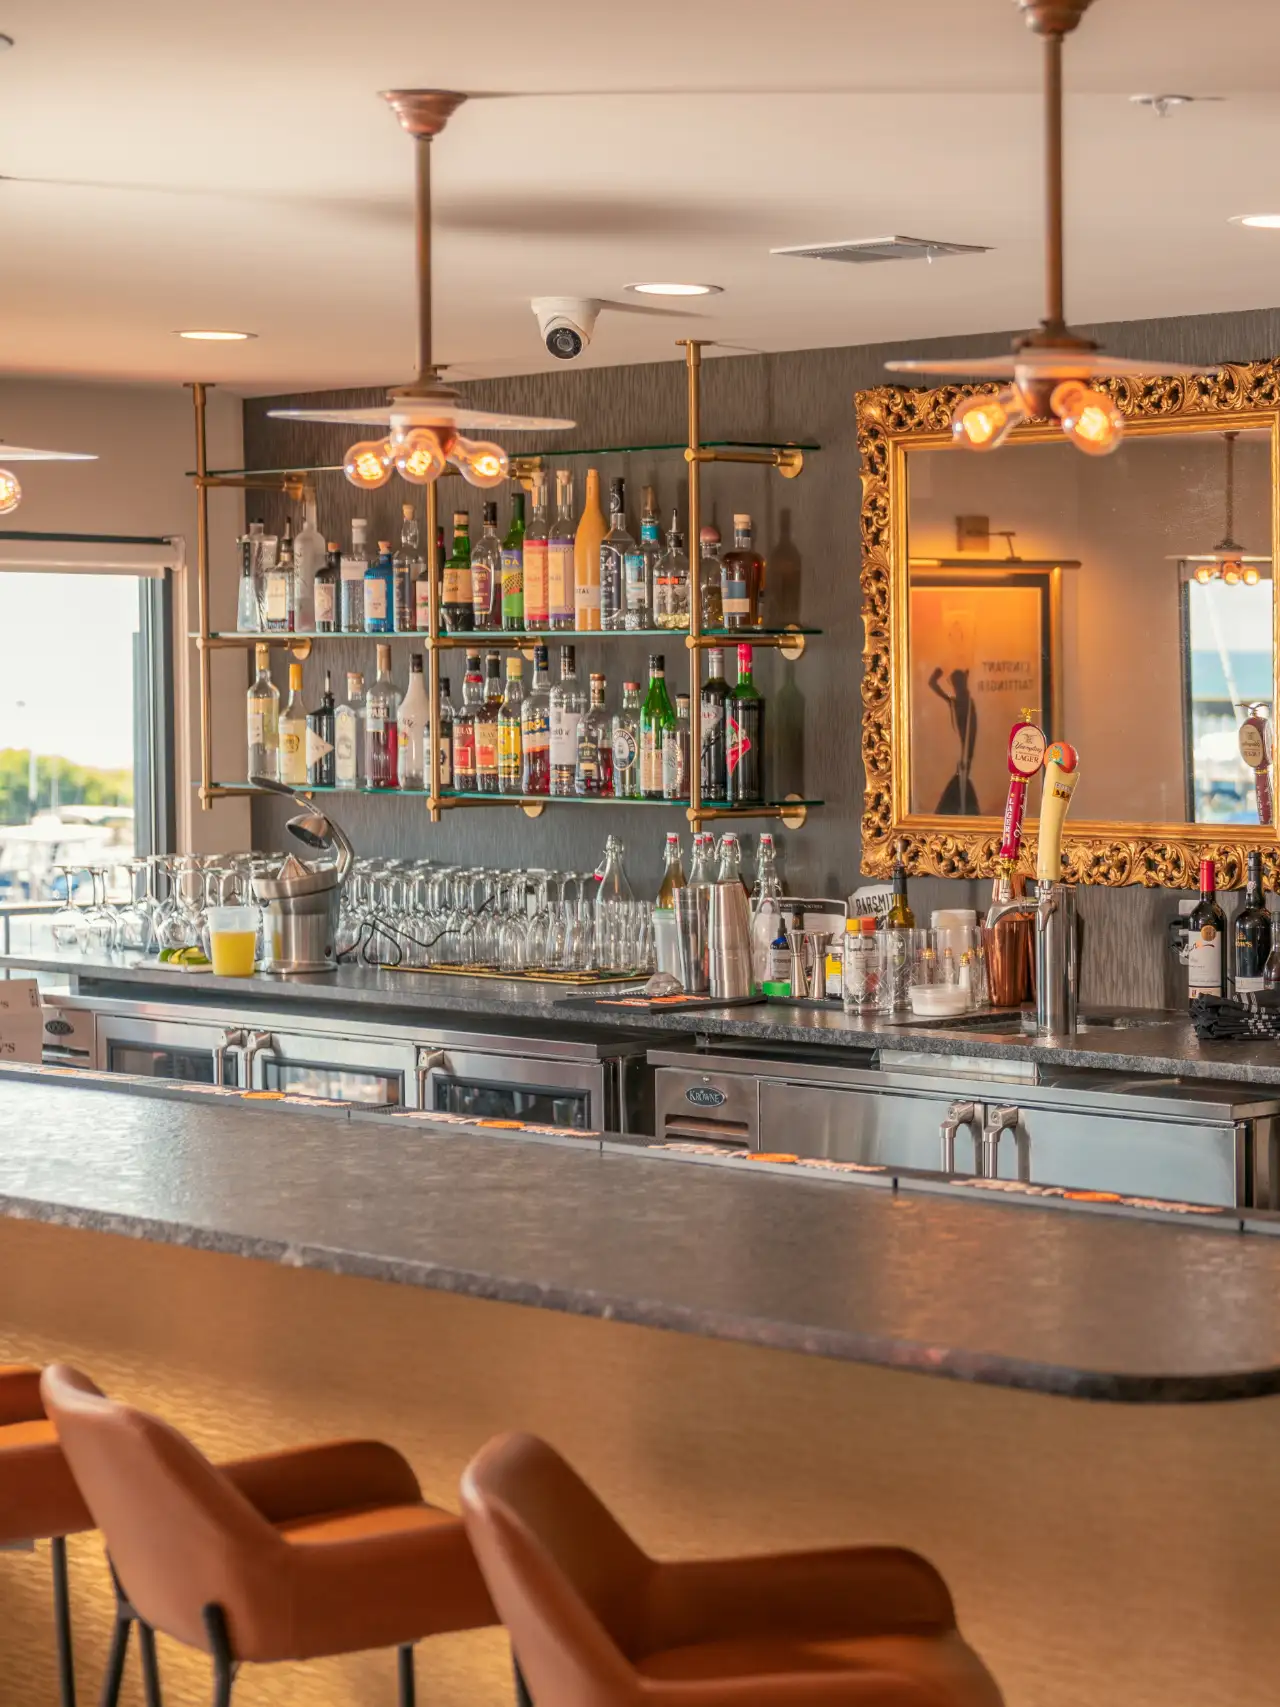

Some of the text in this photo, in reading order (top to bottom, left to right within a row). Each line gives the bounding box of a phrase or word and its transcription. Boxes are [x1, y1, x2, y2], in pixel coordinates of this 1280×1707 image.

[1015, 754, 1039, 763] LAGER
[1005, 798, 1015, 833] LAGER
[689, 1090, 721, 1104] KROWNE
